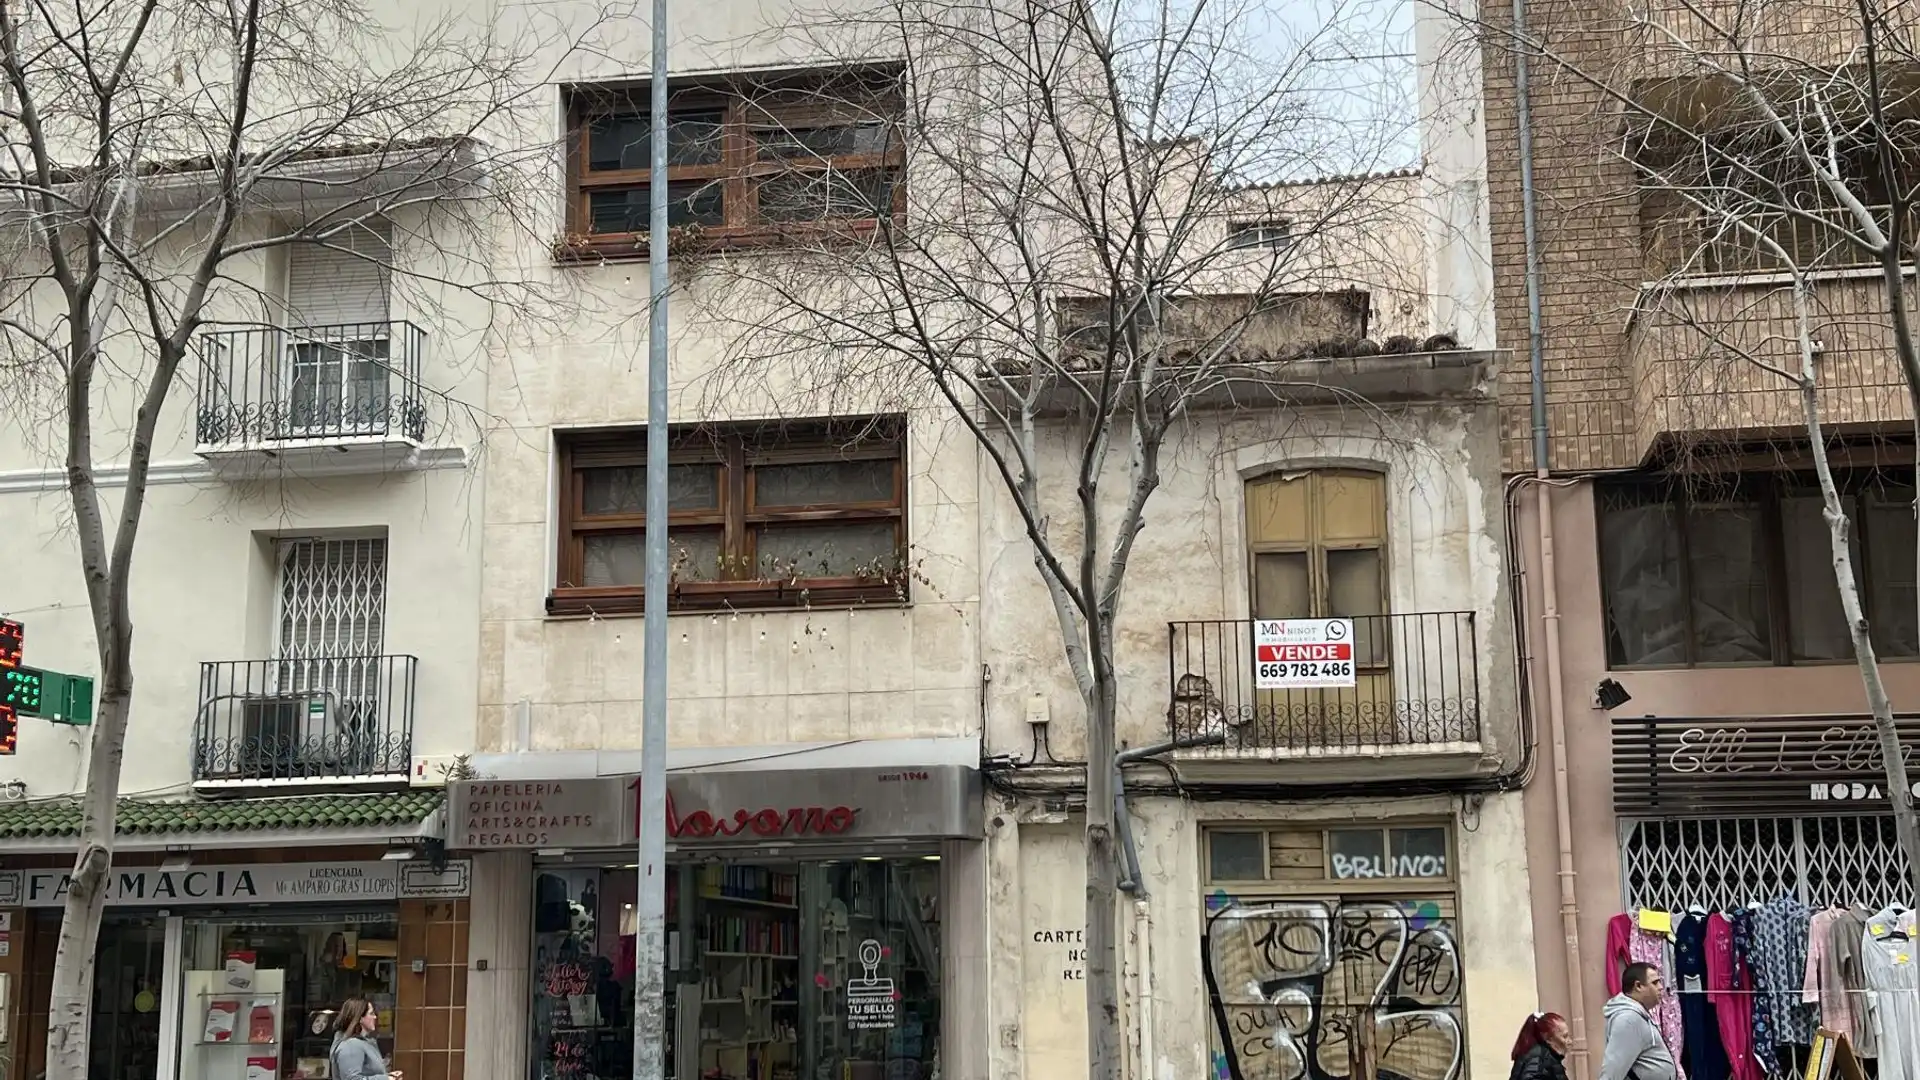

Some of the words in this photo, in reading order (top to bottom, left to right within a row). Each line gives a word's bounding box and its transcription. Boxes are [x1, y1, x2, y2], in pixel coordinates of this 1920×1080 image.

[1261, 622, 1285, 635] MN
[1271, 645, 1339, 660] VENDE
[1260, 664, 1288, 678] 669
[1291, 663, 1318, 677] 782
[1321, 662, 1351, 677] 486
[1810, 783, 1883, 801] MODA
[469, 800, 544, 814] OFICINA
[468, 815, 593, 829] ARTS&CRAFTS
[468, 832, 549, 846] REGALOS
[309, 867, 364, 878] LICENCIADA
[29, 870, 257, 900] FAMACIA
[291, 880, 330, 895] AMPARO
[333, 878, 360, 894] GRAS
[362, 877, 395, 893] LLOPIS
[848, 1004, 861, 1014] TU
[863, 1004, 895, 1014] SELLO
